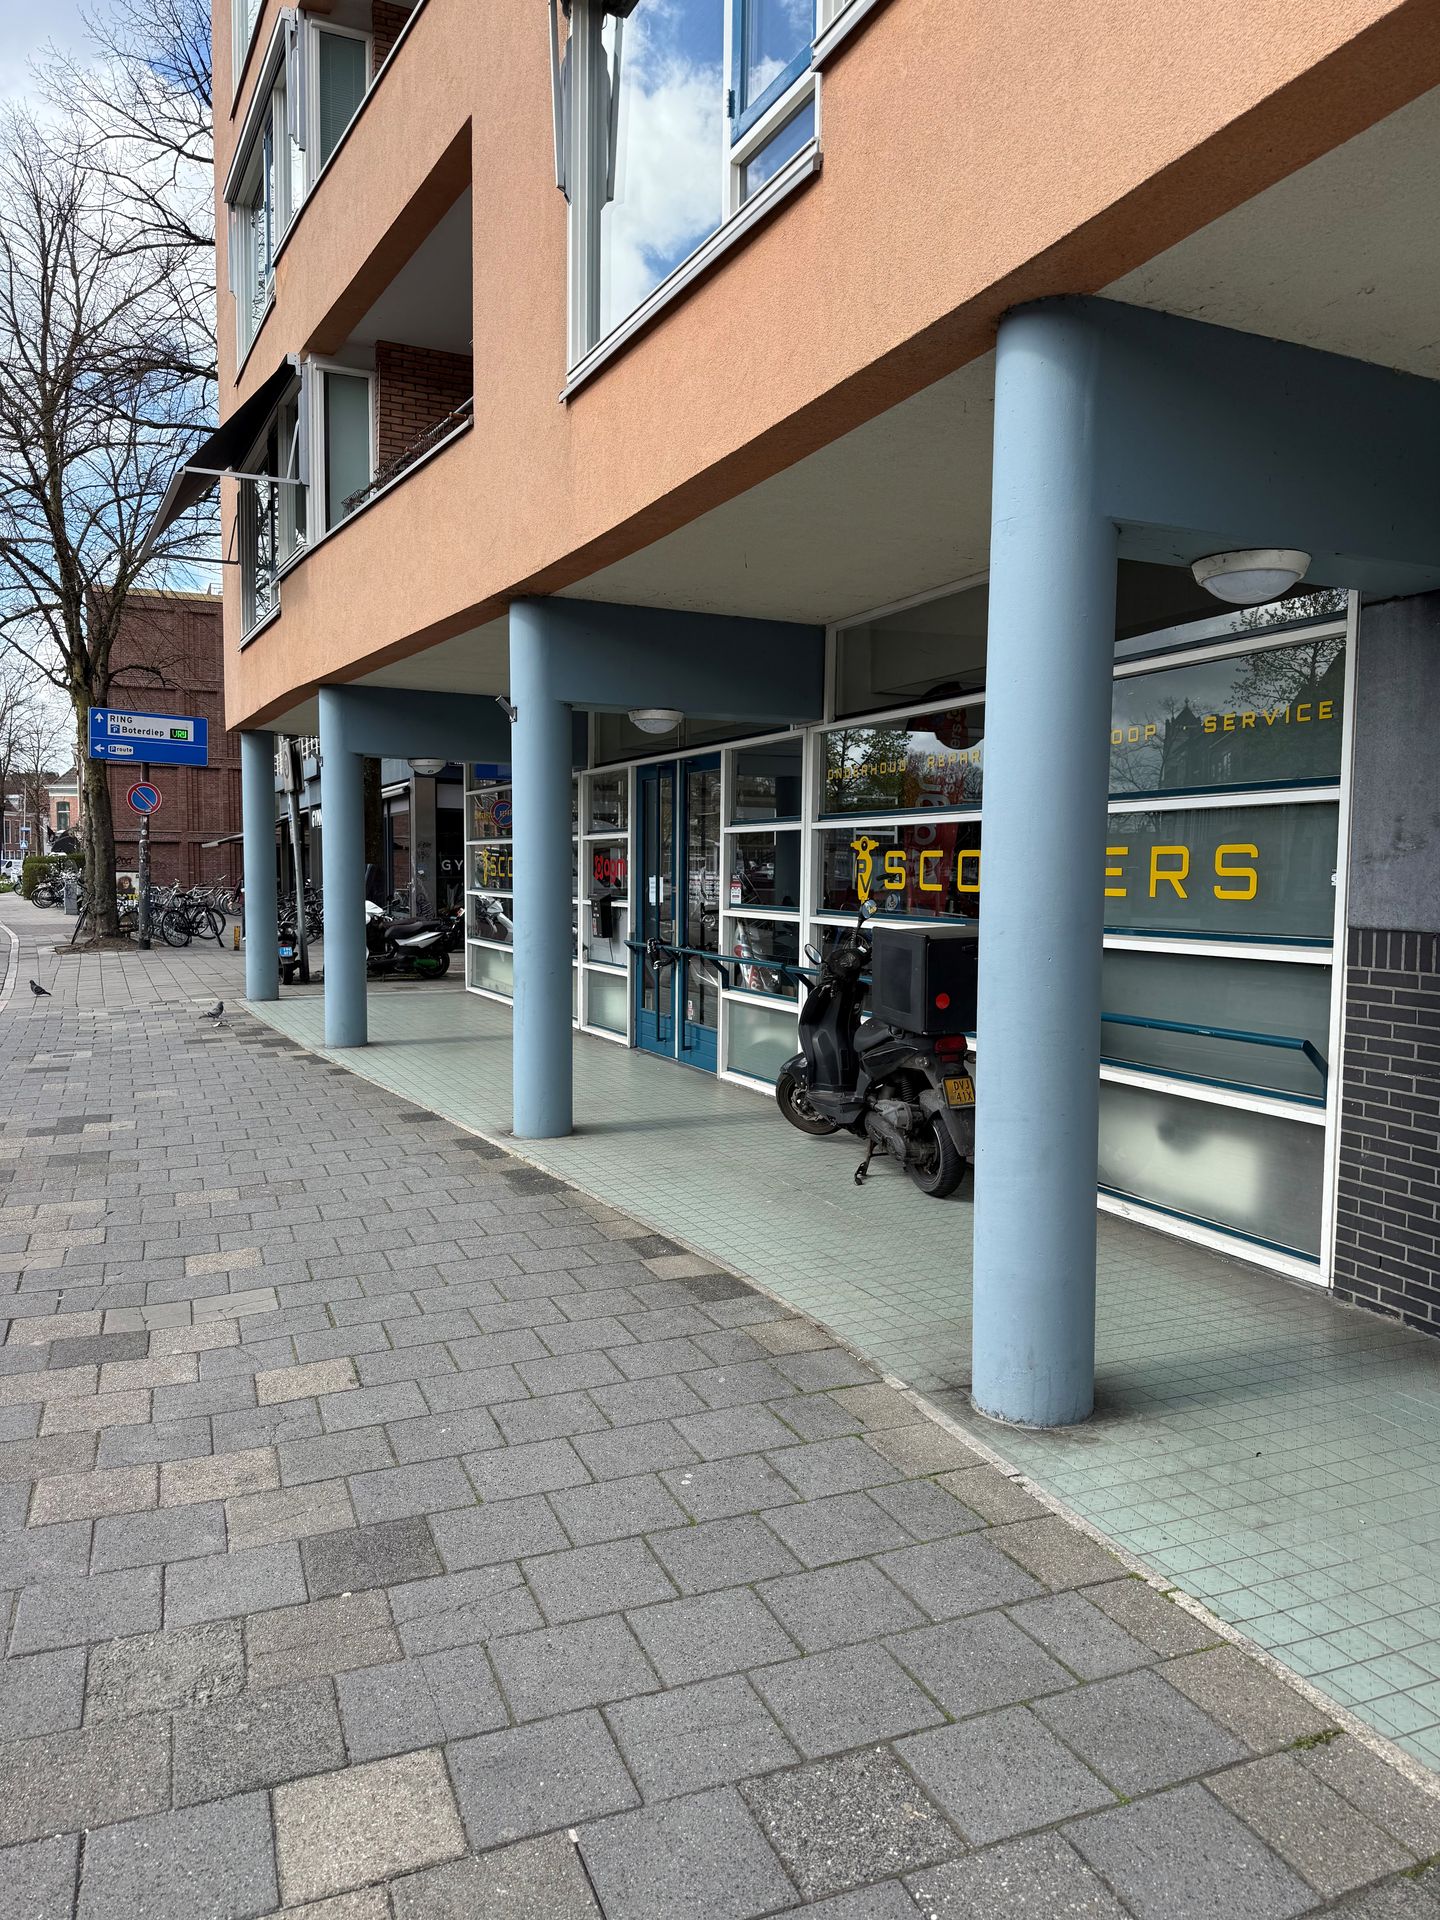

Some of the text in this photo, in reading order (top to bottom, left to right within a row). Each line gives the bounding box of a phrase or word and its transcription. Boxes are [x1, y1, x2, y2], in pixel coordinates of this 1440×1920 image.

[109, 714, 133, 724] RING
[121, 726, 165, 737] Boterdiep
[827, 699, 1335, 780] ONDERHOUD REPAR OOP SERVICE
[441, 859, 464, 871] GY
[489, 856, 513, 878] SCO
[953, 1080, 970, 1091] DVJ
[956, 1091, 973, 1102] 41X
